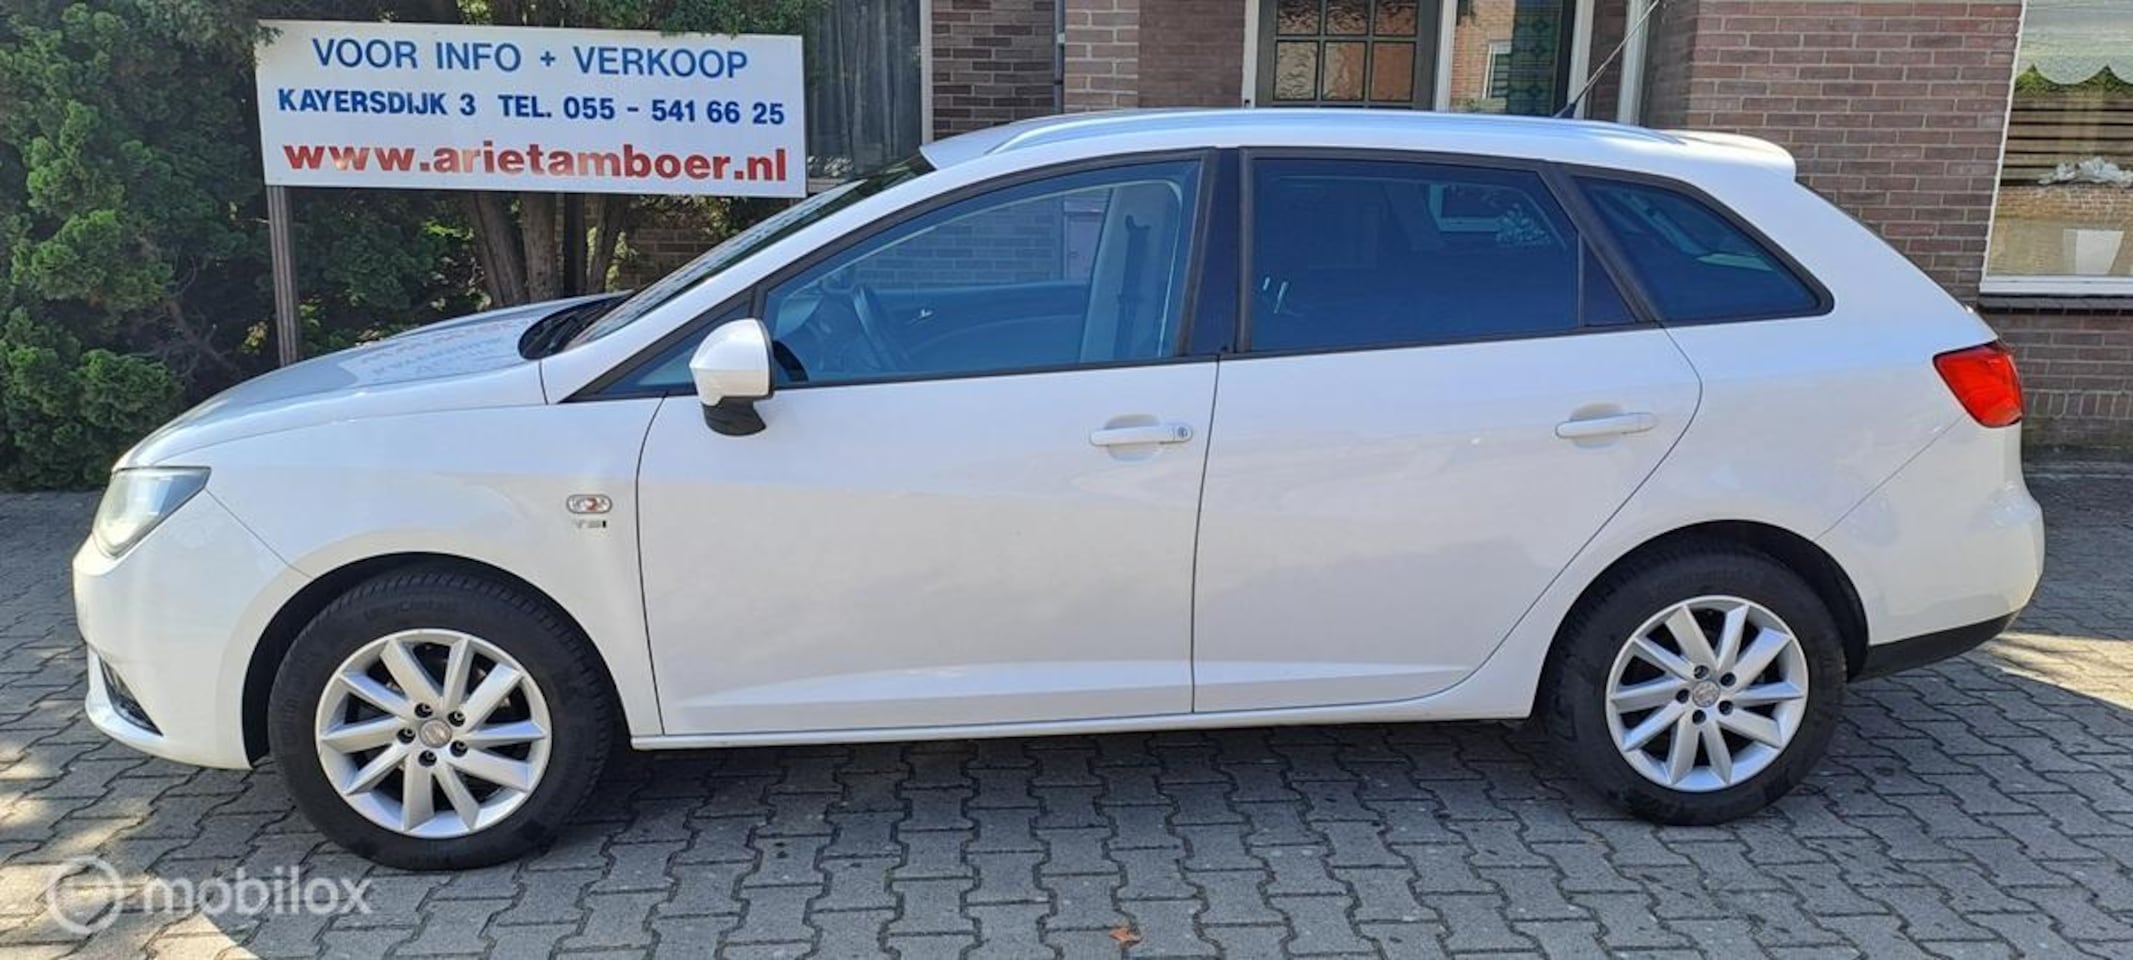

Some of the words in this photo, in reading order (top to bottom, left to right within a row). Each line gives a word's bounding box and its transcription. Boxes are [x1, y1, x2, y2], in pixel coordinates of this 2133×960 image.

[312, 38, 418, 68] VOOR
[435, 41, 522, 72] INFO
[539, 50, 556, 68] +
[573, 46, 748, 78] VERKOOP
[277, 88, 447, 115] KAYERSDIJK
[459, 93, 477, 116] 3
[497, 95, 552, 119] TEL.
[563, 97, 616, 120] 055
[651, 99, 696, 122] 541
[707, 101, 740, 123] 66
[752, 102, 785, 124] 25
[283, 140, 787, 181] www.arietamboer.nl
